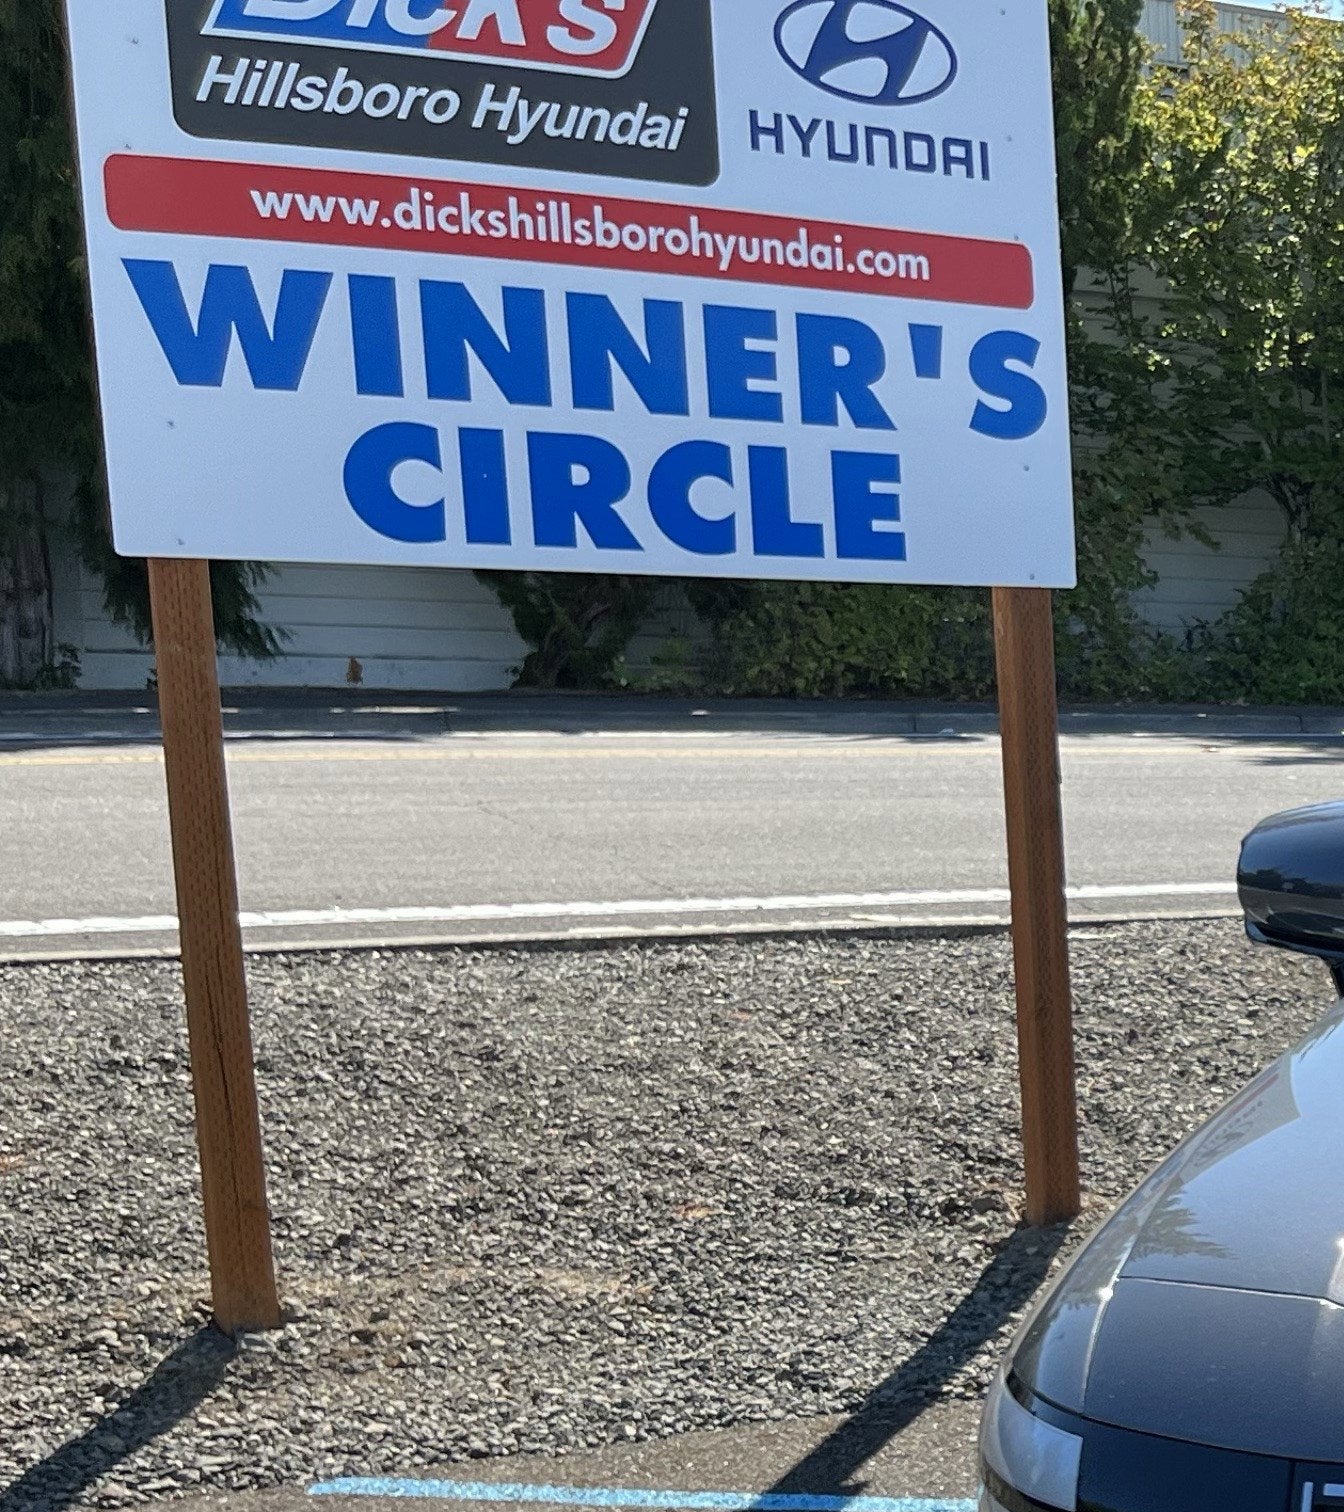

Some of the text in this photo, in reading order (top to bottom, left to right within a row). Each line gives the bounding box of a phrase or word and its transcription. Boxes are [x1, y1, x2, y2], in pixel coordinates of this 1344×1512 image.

[196, 55, 690, 152] Hillsboro Hyundai
[748, 109, 990, 181] HYUNDAI
[249, 186, 930, 281] www.dickshillsborohyundai.com
[121, 257, 1048, 440] WINNER'S
[343, 420, 907, 561] CIRCLE
